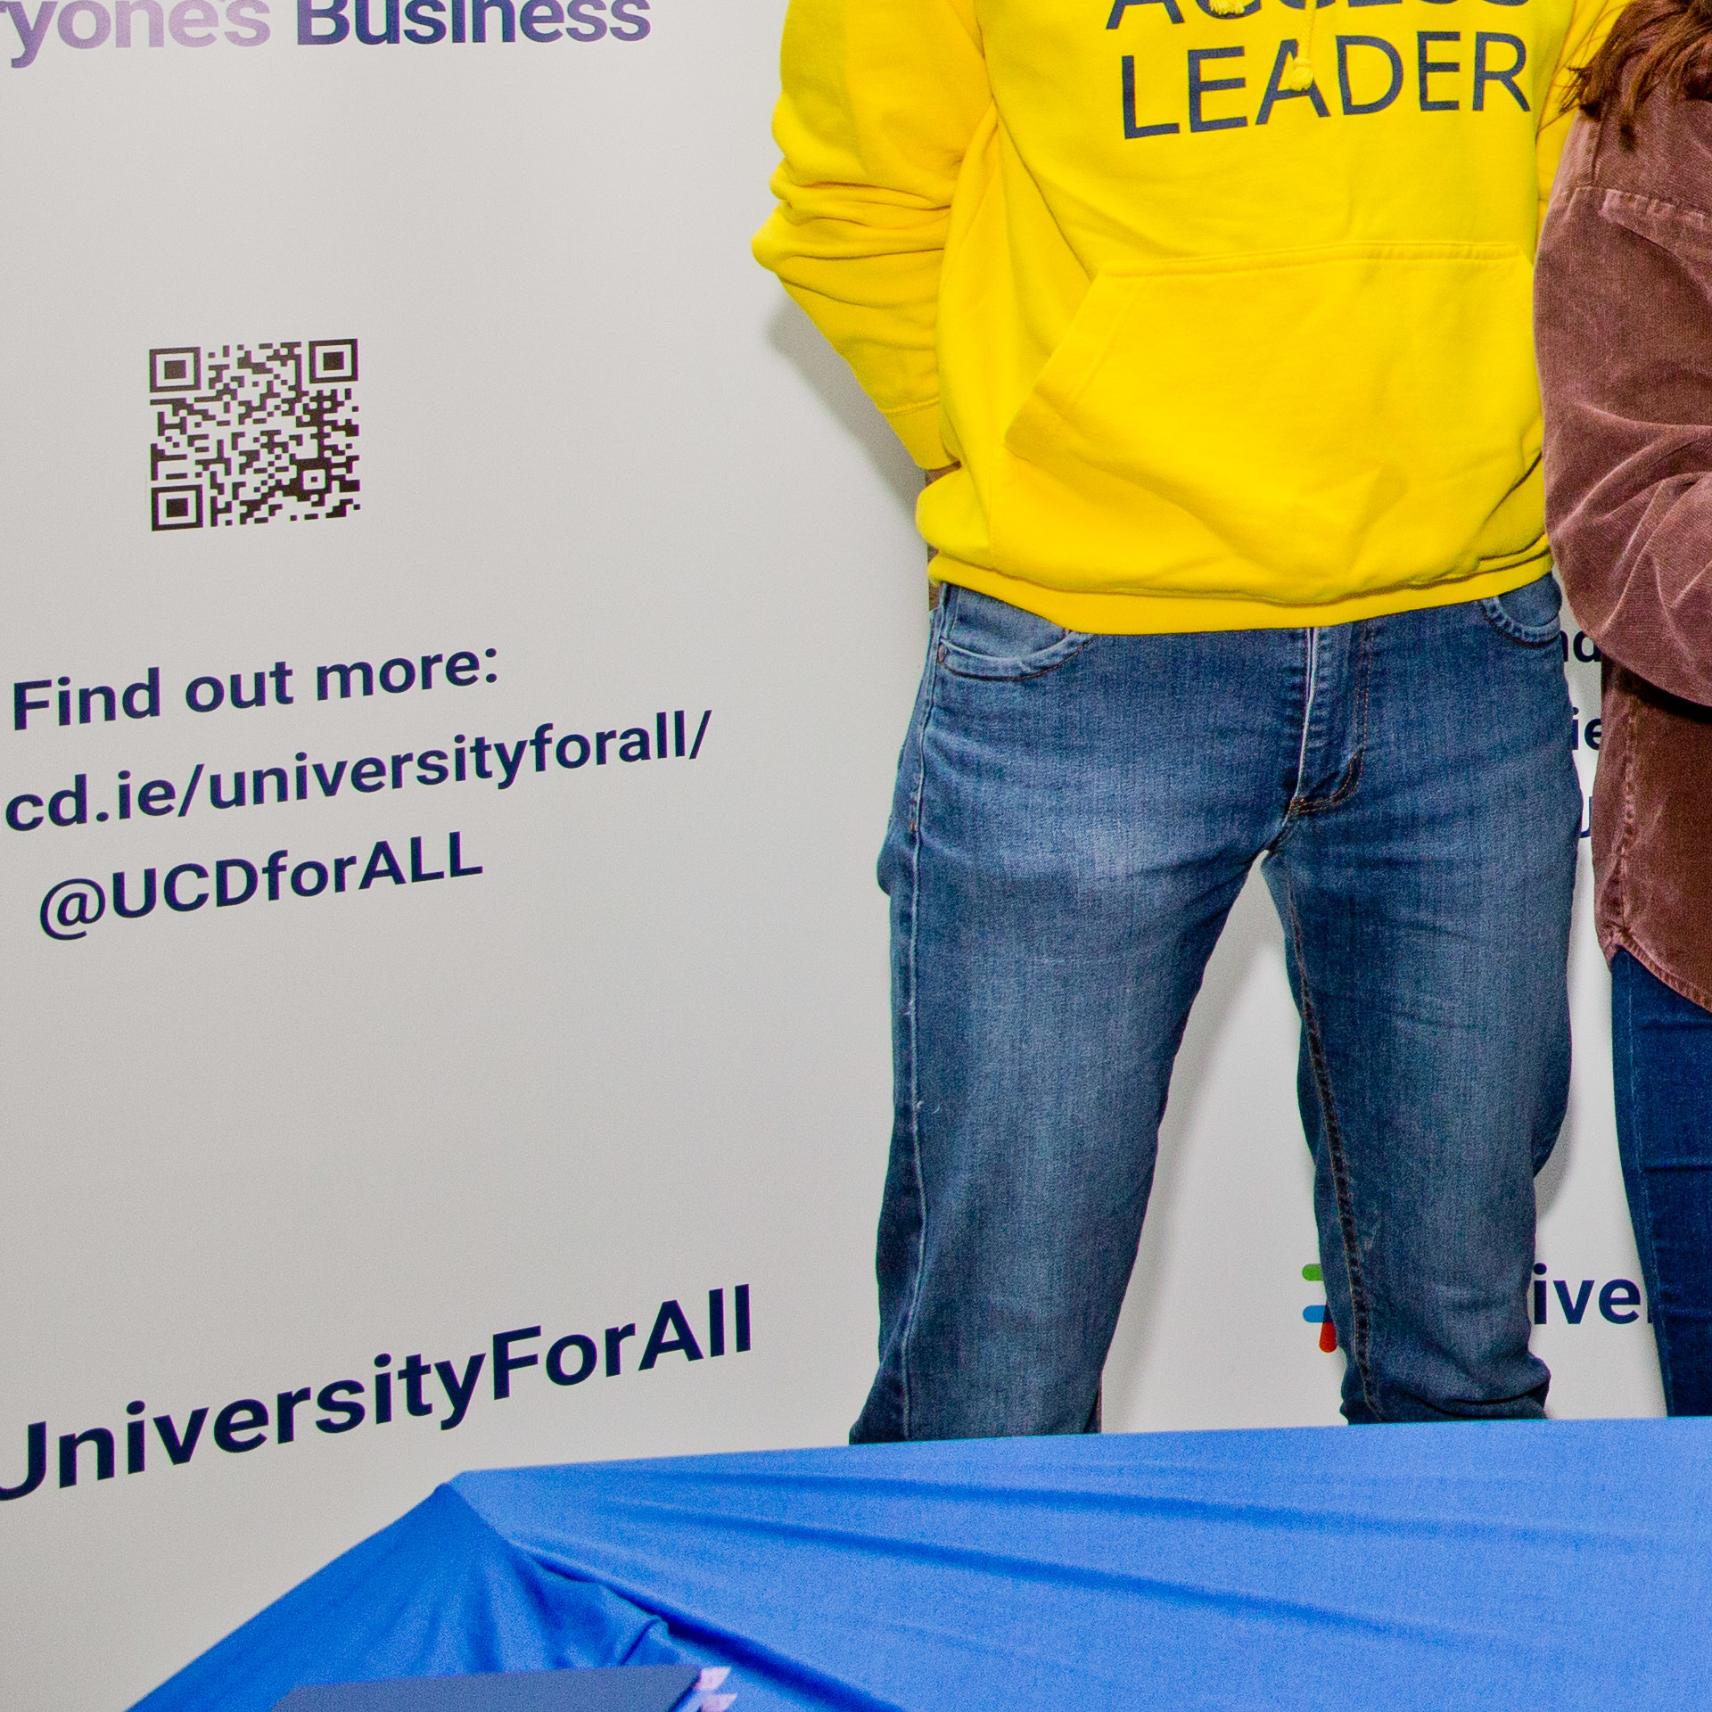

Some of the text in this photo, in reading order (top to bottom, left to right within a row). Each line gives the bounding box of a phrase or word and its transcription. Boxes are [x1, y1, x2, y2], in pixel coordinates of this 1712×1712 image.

[1119, 30, 1533, 142] LEADER
[14, 648, 497, 730] Find out more:
[5, 709, 711, 835] cd.ie/universityforall/
[40, 832, 483, 940] @UCDforALL
